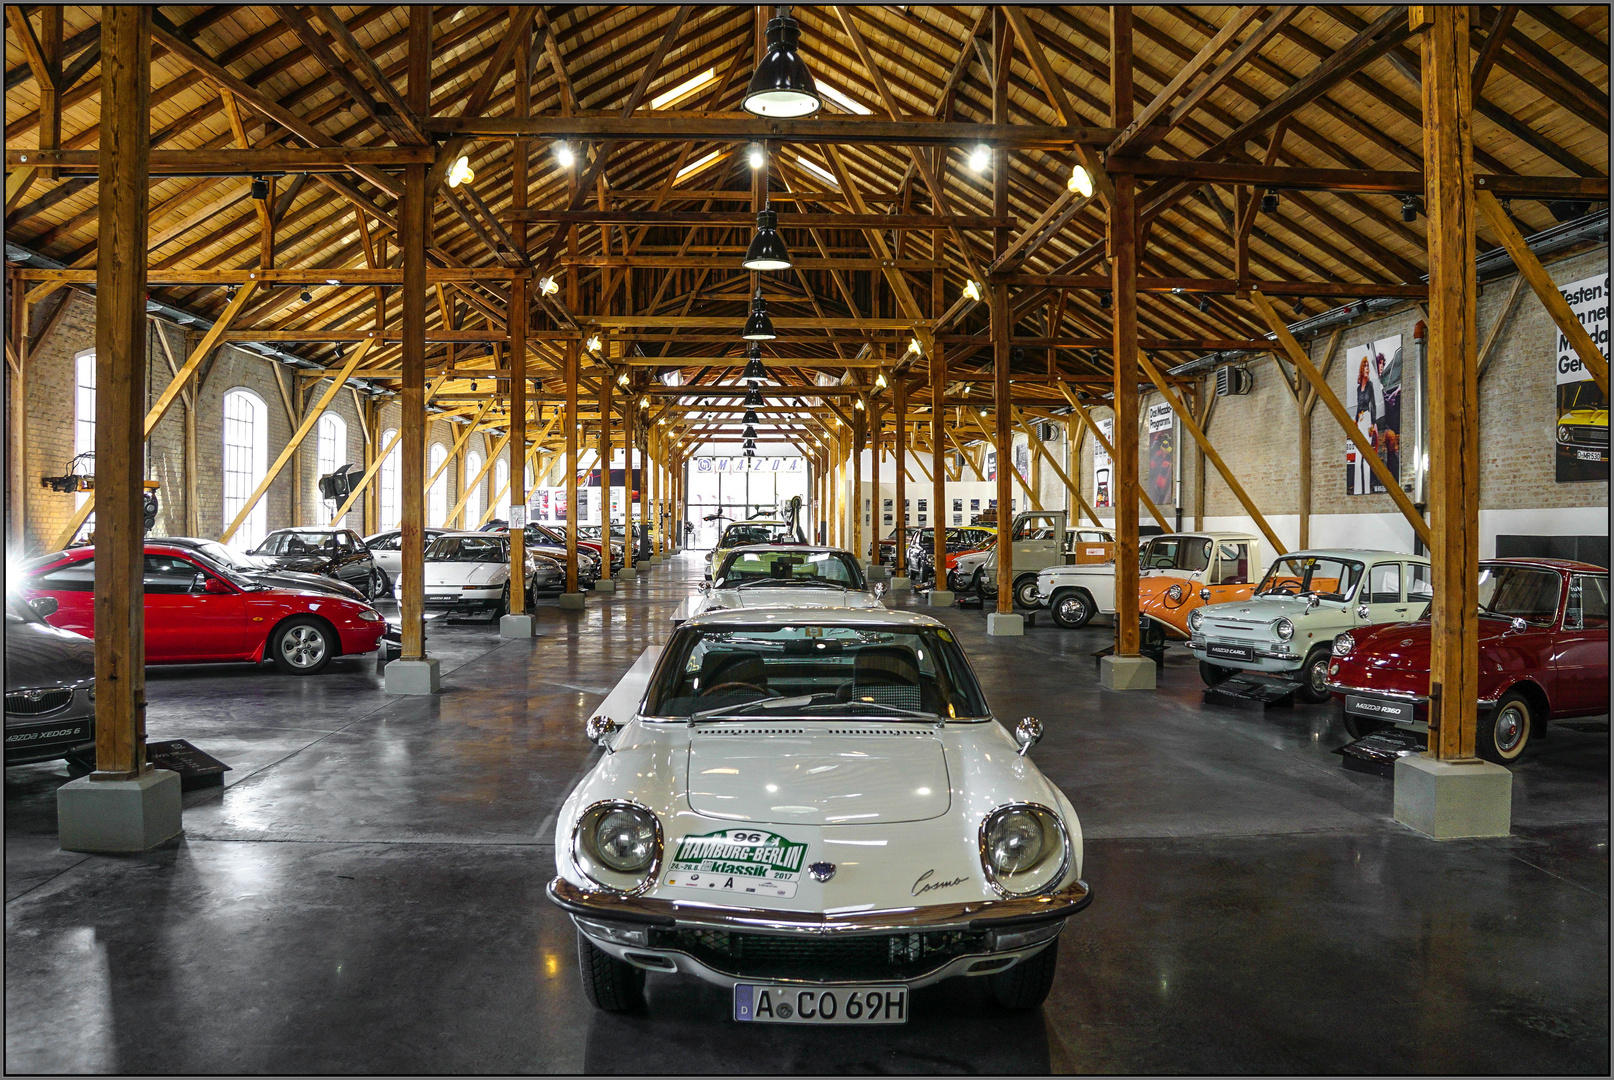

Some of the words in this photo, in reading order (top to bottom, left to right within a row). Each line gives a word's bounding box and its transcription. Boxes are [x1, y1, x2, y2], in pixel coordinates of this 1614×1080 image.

[718, 459, 798, 471] MAZDA
[1381, 706, 1401, 715] R360
[39, 728, 73, 739] XEDOS
[73, 727, 81, 735] 6
[733, 832, 761, 843] 96
[678, 841, 804, 870] HAMBURG-BERLIN
[711, 861, 769, 878] klassik
[774, 872, 793, 880] 2017
[911, 869, 970, 897] Cosmo
[740, 1006, 749, 1015] D
[755, 990, 774, 1018] A
[797, 991, 838, 1020] CO
[846, 991, 904, 1019] 69H
